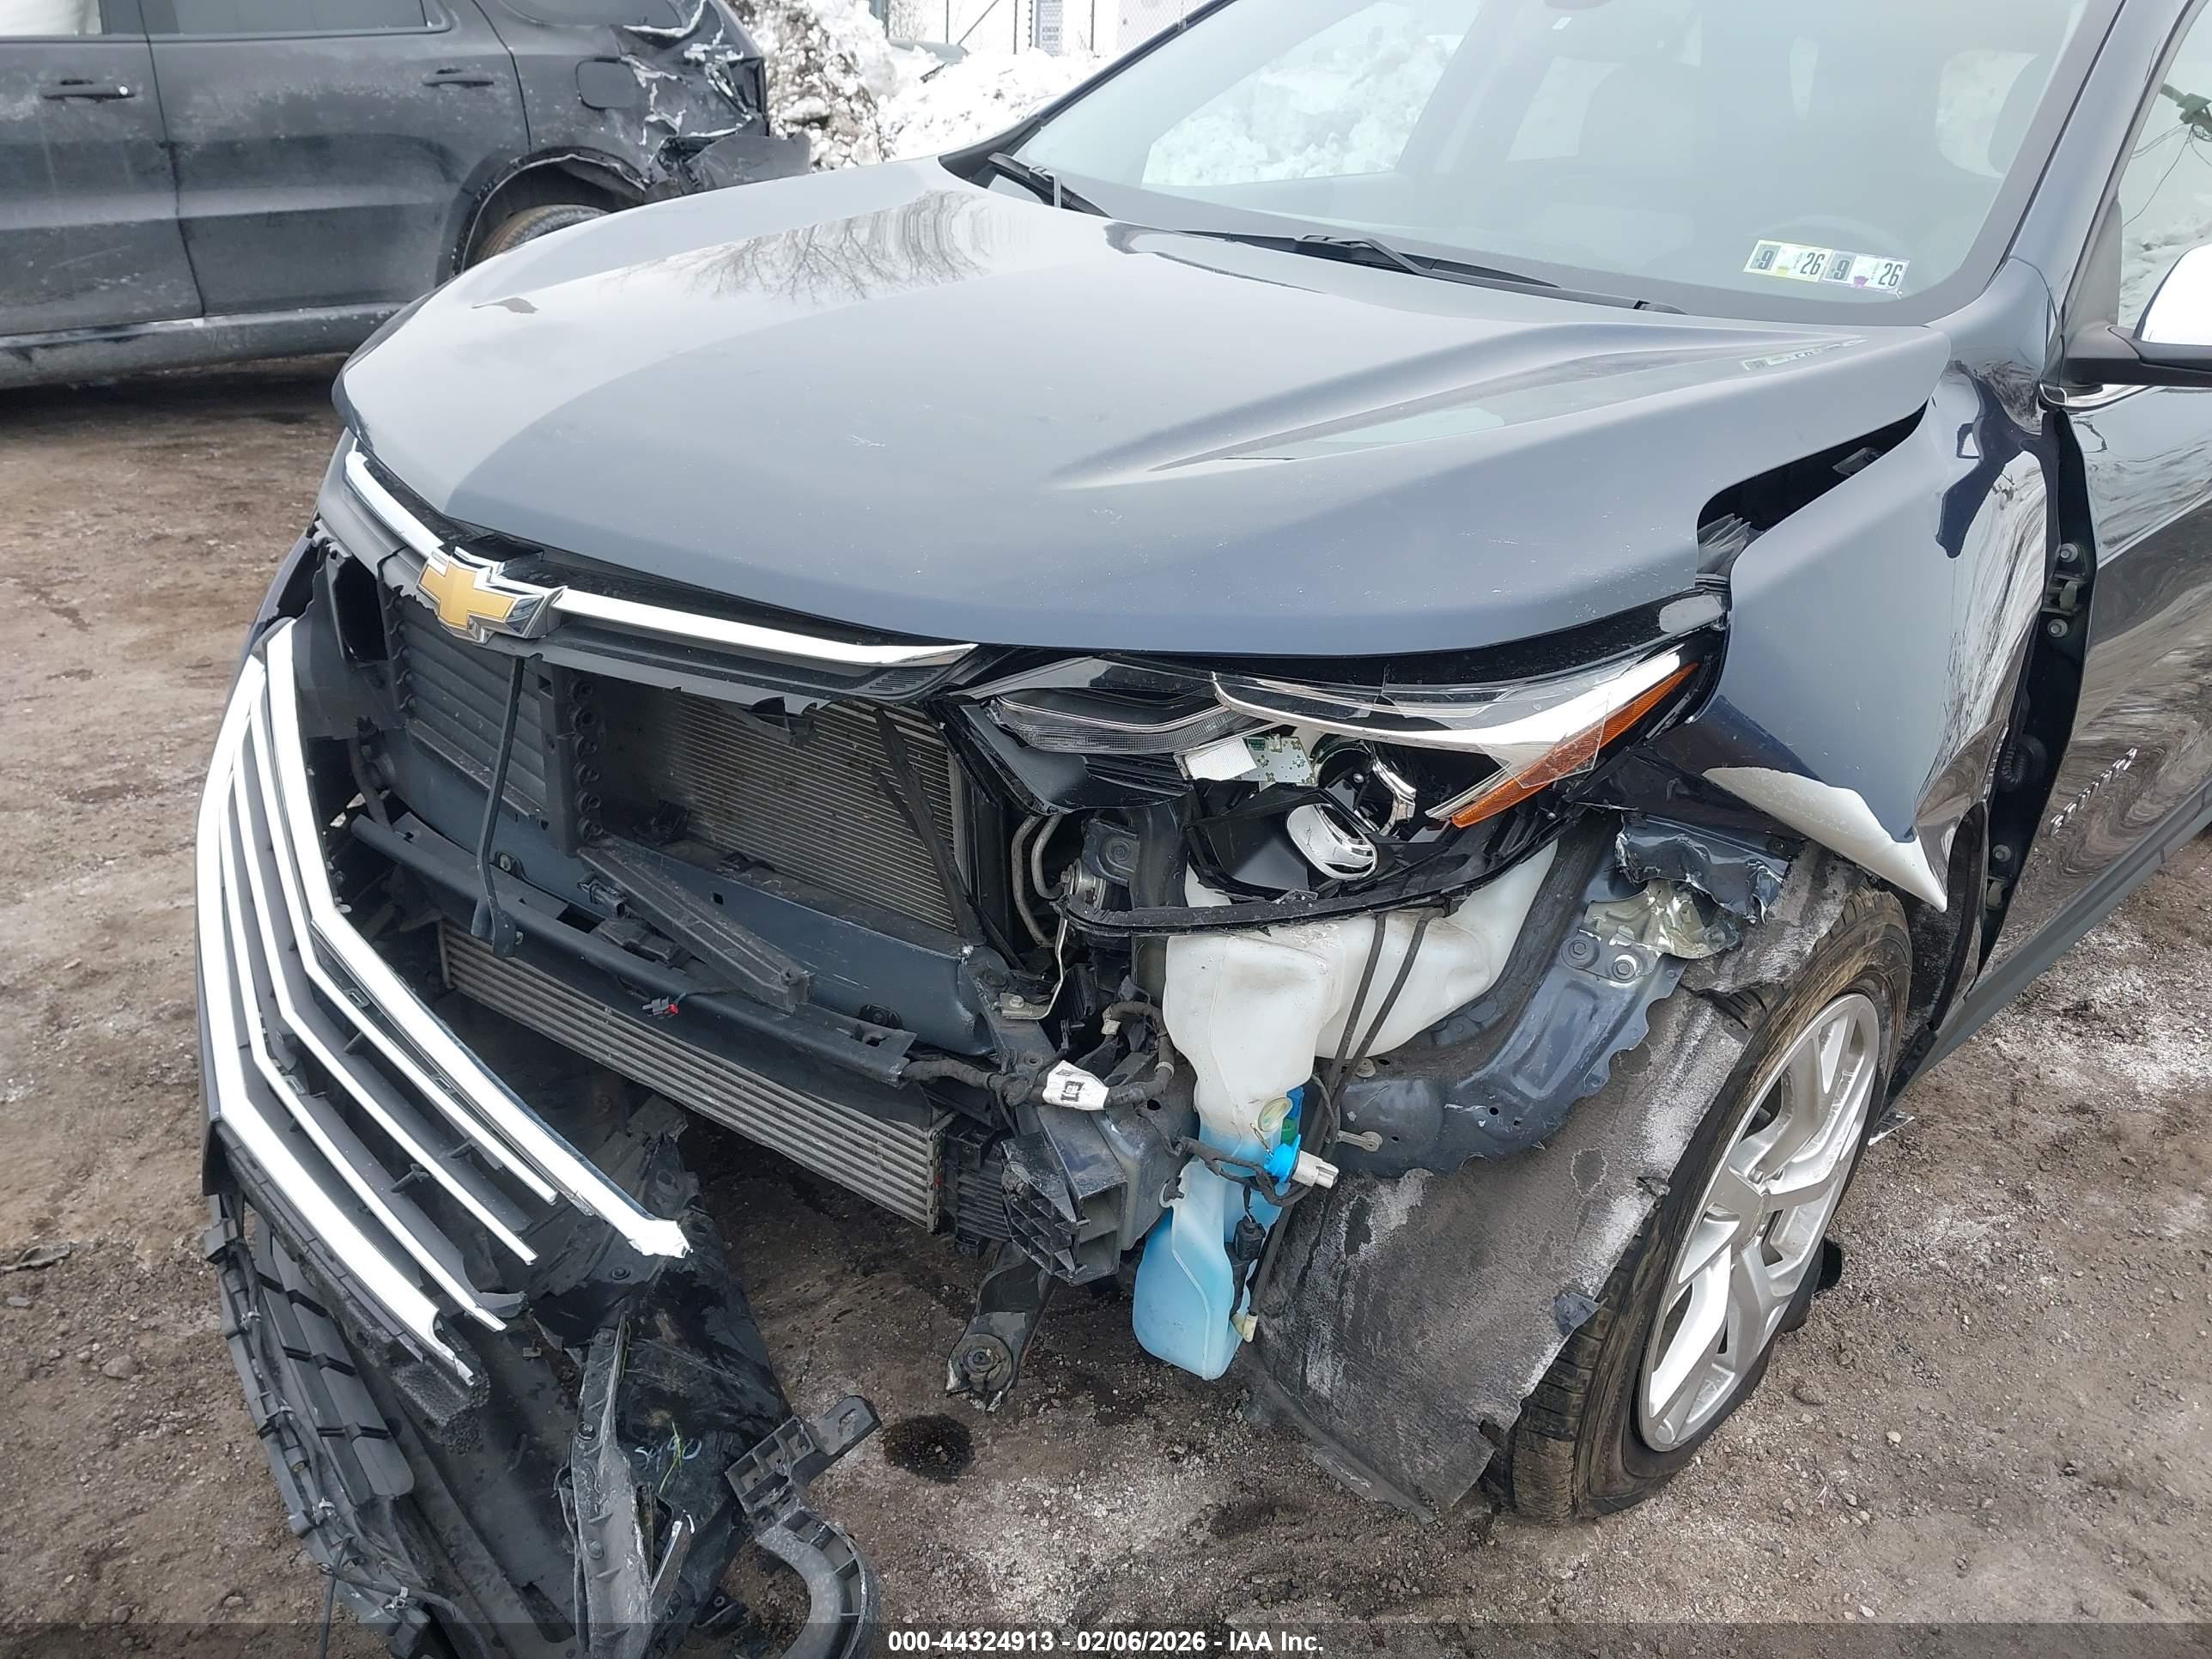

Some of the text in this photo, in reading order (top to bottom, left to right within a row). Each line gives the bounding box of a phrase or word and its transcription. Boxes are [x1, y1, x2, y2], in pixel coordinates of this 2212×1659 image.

[1758, 250, 1774, 270] 9
[1799, 252, 1825, 276] 26
[1833, 260, 1850, 280] 9
[1877, 263, 1903, 287] 26
